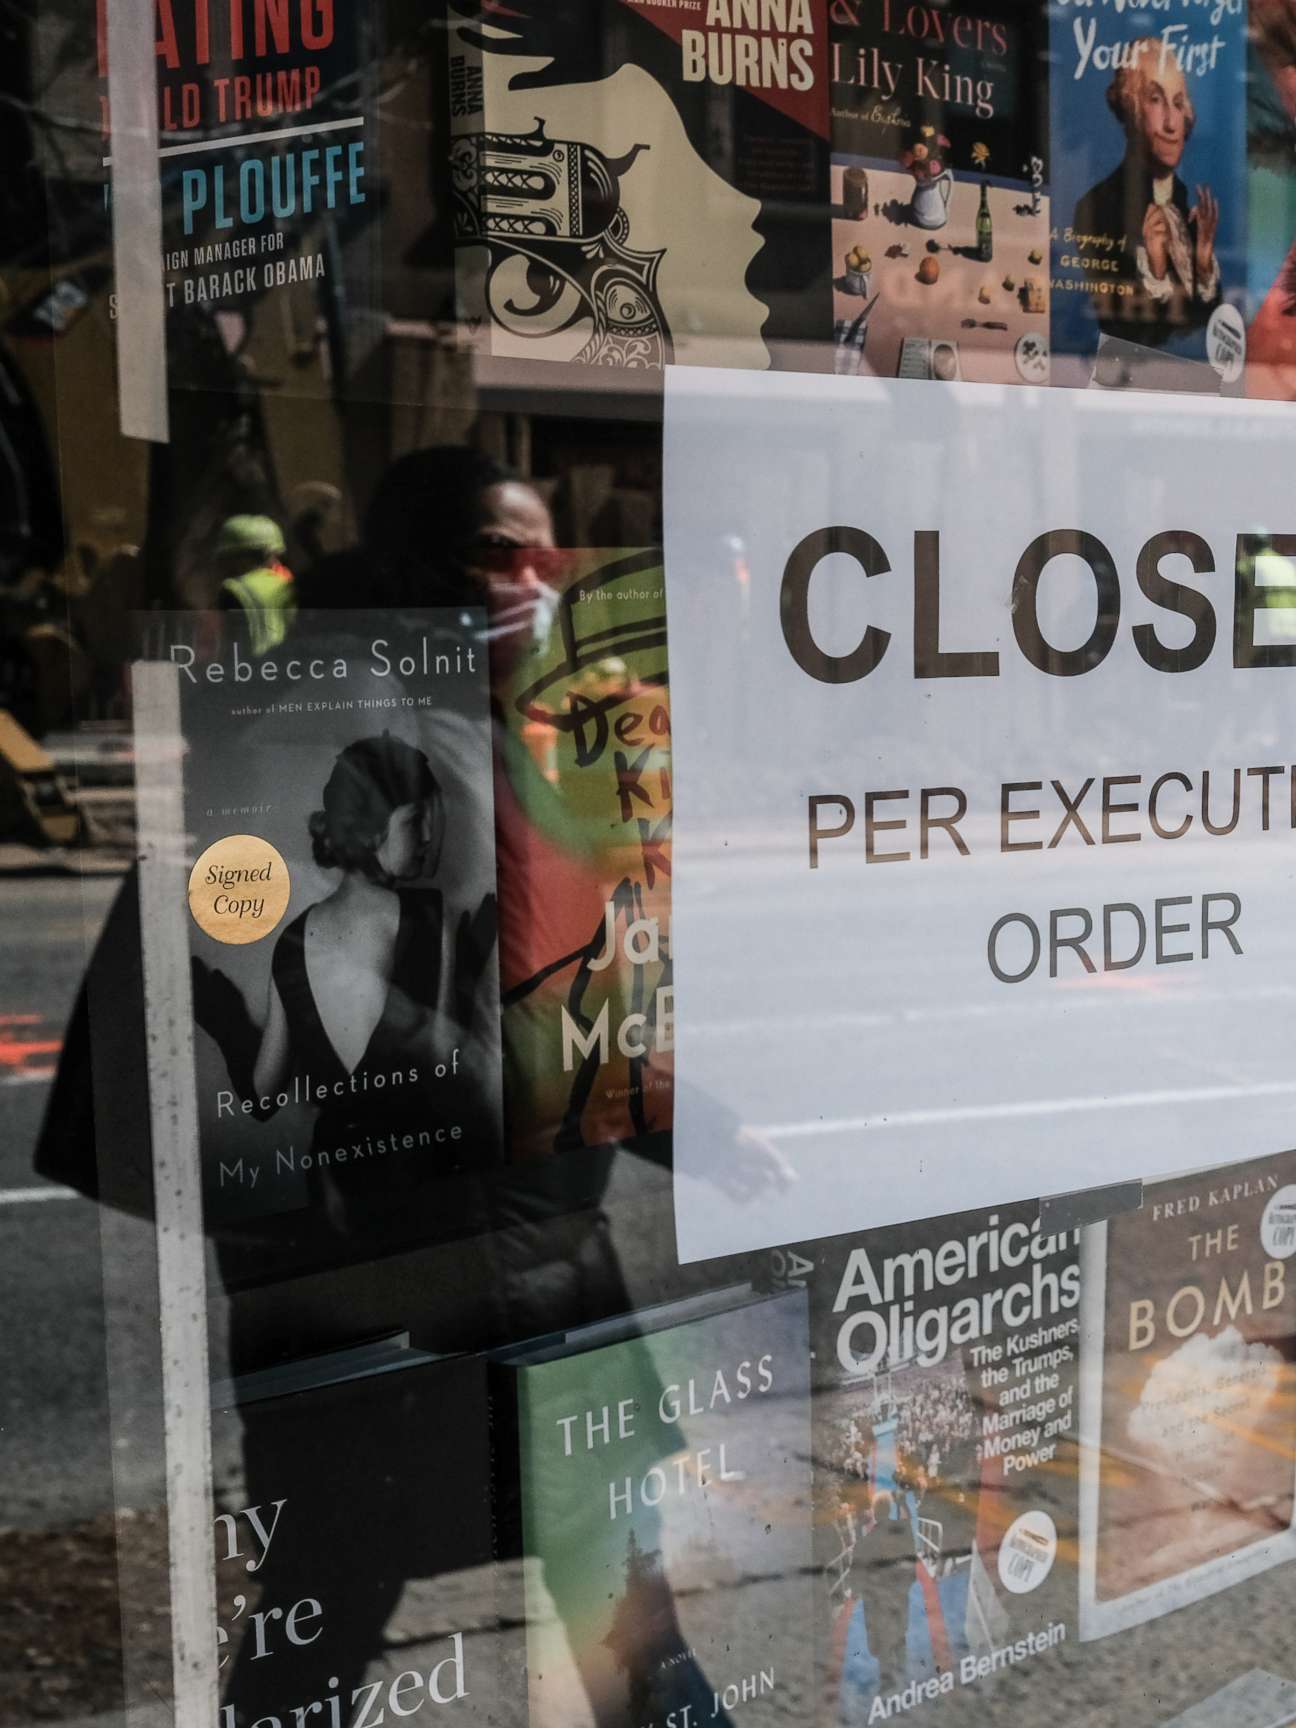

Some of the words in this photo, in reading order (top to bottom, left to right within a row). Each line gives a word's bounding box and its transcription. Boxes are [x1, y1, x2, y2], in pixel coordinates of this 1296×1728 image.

[705, 0, 815, 35] ANNA
[880, 0, 1008, 57] Lovers
[681, 28, 815, 92] BURNS
[1073, 16, 1150, 80] Your
[1160, 23, 1226, 77] First
[214, 65, 321, 123] TRUMP
[831, 42, 903, 100] Lily
[916, 56, 994, 119] King
[182, 141, 366, 236] PLOUFFE
[193, 236, 256, 266] MANAGER
[260, 231, 284, 254] FOR
[1060, 255, 1119, 272] GEORGE
[183, 265, 257, 305] BARACK
[263, 252, 326, 289] OBAMA
[596, 590, 613, 601] the
[616, 590, 650, 601] author
[170, 643, 349, 684] Rebecca
[370, 636, 477, 678] Solnit
[278, 703, 303, 714] MEN
[306, 701, 354, 712] EXPLAIN
[357, 697, 398, 709] THINGS
[400, 697, 415, 706] TO
[417, 696, 433, 705] ME
[566, 690, 671, 768] Dea
[807, 786, 972, 870] PER
[204, 861, 273, 890] Signed
[213, 893, 266, 919] Copy
[586, 901, 672, 971] Ja
[987, 891, 1245, 985] ORDER
[216, 1066, 419, 1118] Recollections
[435, 1048, 461, 1079] of
[219, 1156, 261, 1188] My
[276, 1122, 464, 1174] Nonexistence
[1151, 1198, 1201, 1222] FRED
[1207, 1174, 1279, 1206] KAPLAN
[1188, 1223, 1241, 1262] THE
[836, 1262, 1080, 1375] Oligarchs
[1129, 1260, 1287, 1352] BOMB
[970, 1342, 1002, 1368] The
[1006, 1316, 1080, 1353] Kushners,
[980, 1364, 1009, 1389] the
[1011, 1343, 1075, 1378] Trumps,
[556, 1397, 637, 1457] THE
[657, 1353, 774, 1425] GLASS
[982, 1403, 1057, 1437] Marriage
[1058, 1385, 1074, 1408] of
[999, 1380, 1031, 1407] and
[1034, 1371, 1060, 1394] the
[983, 1426, 1040, 1459] Money
[1043, 1410, 1072, 1437] and
[1003, 1442, 1057, 1476] Power
[608, 1443, 746, 1521] HOTEL
[711, 1666, 775, 1719] JOHN
[868, 1670, 954, 1726] Andrea
[960, 1621, 1066, 1685] Bernstein
